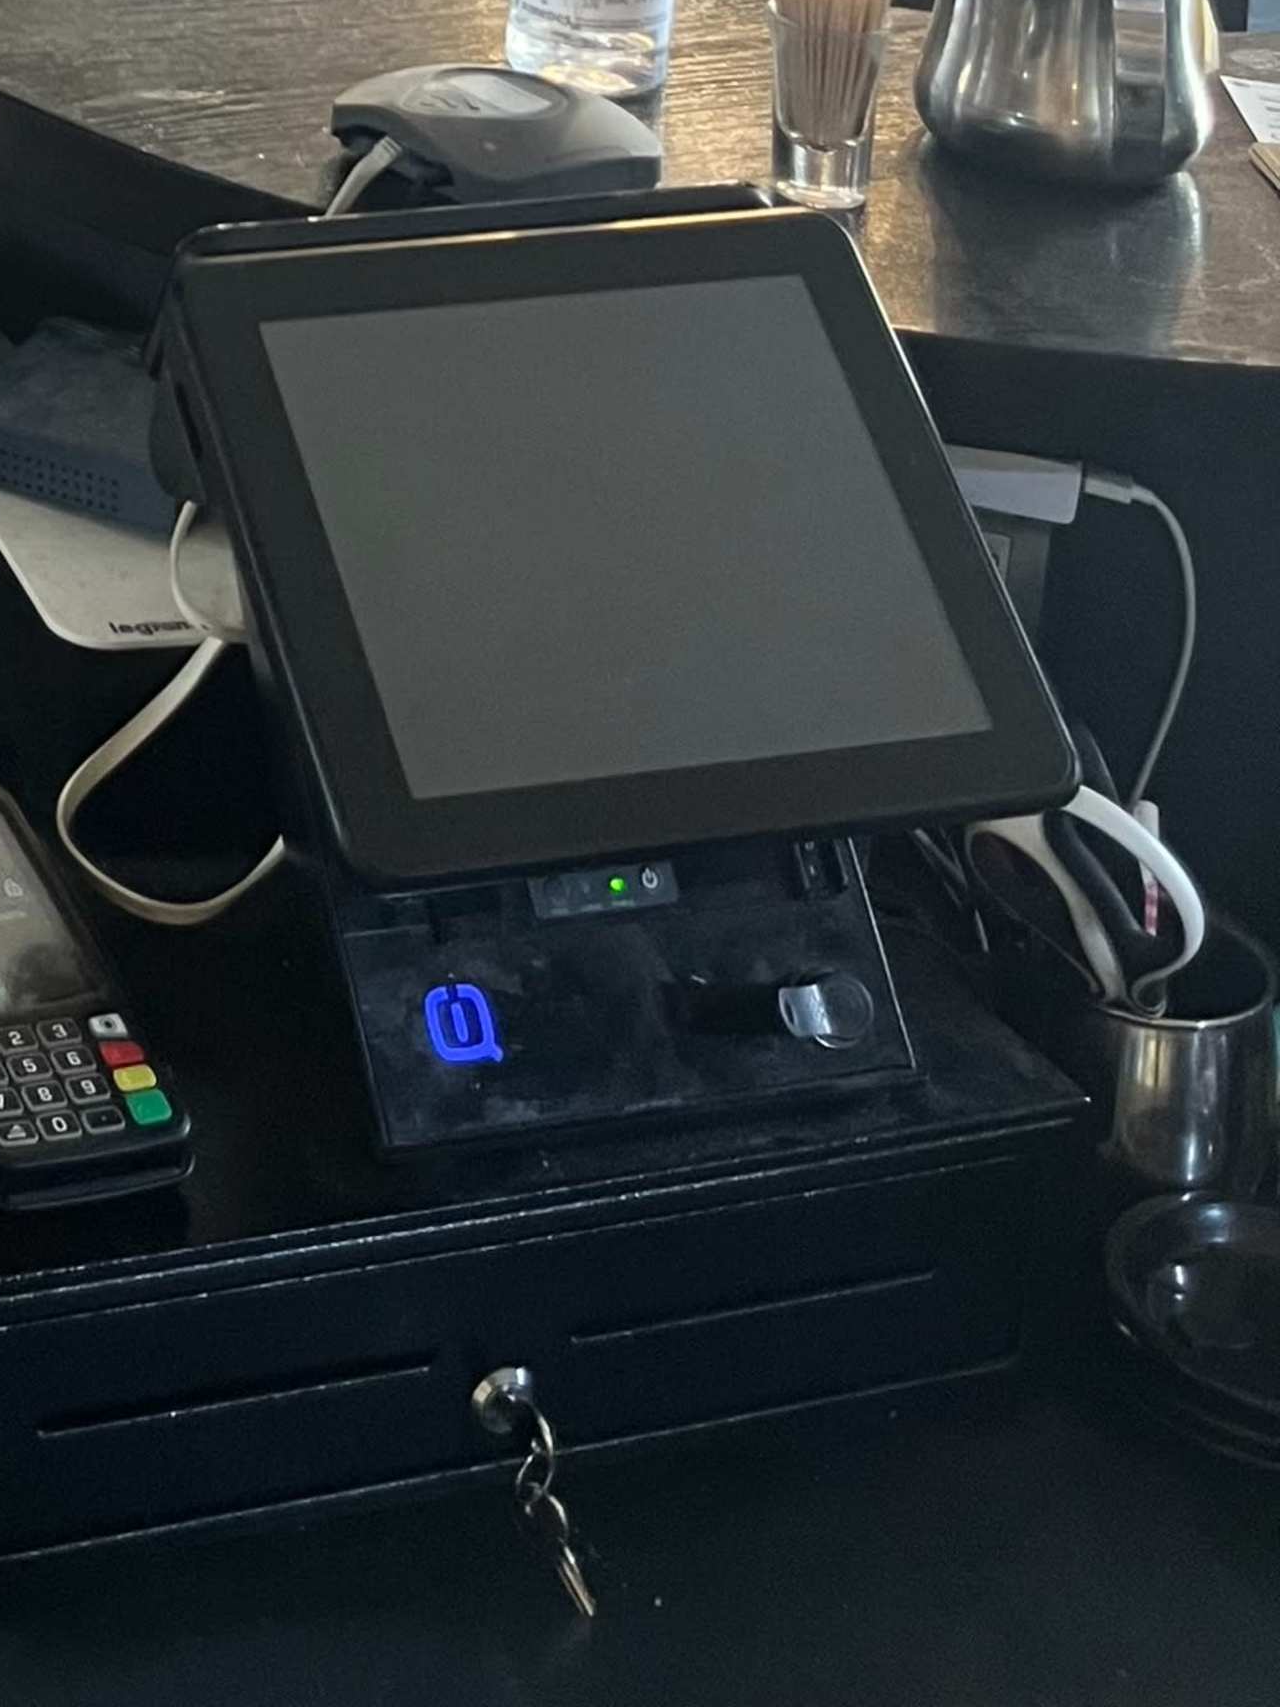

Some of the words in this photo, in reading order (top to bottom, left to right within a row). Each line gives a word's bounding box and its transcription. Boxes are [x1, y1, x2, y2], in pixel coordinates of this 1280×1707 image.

[108, 621, 209, 635] legran
[8, 1030, 24, 1046] 2
[52, 1023, 68, 1038] 3
[21, 1059, 37, 1073] 5
[66, 1051, 82, 1066] 6
[37, 1087, 53, 1102] 8
[80, 1079, 97, 1095] 9
[51, 1116, 68, 1132] 0
